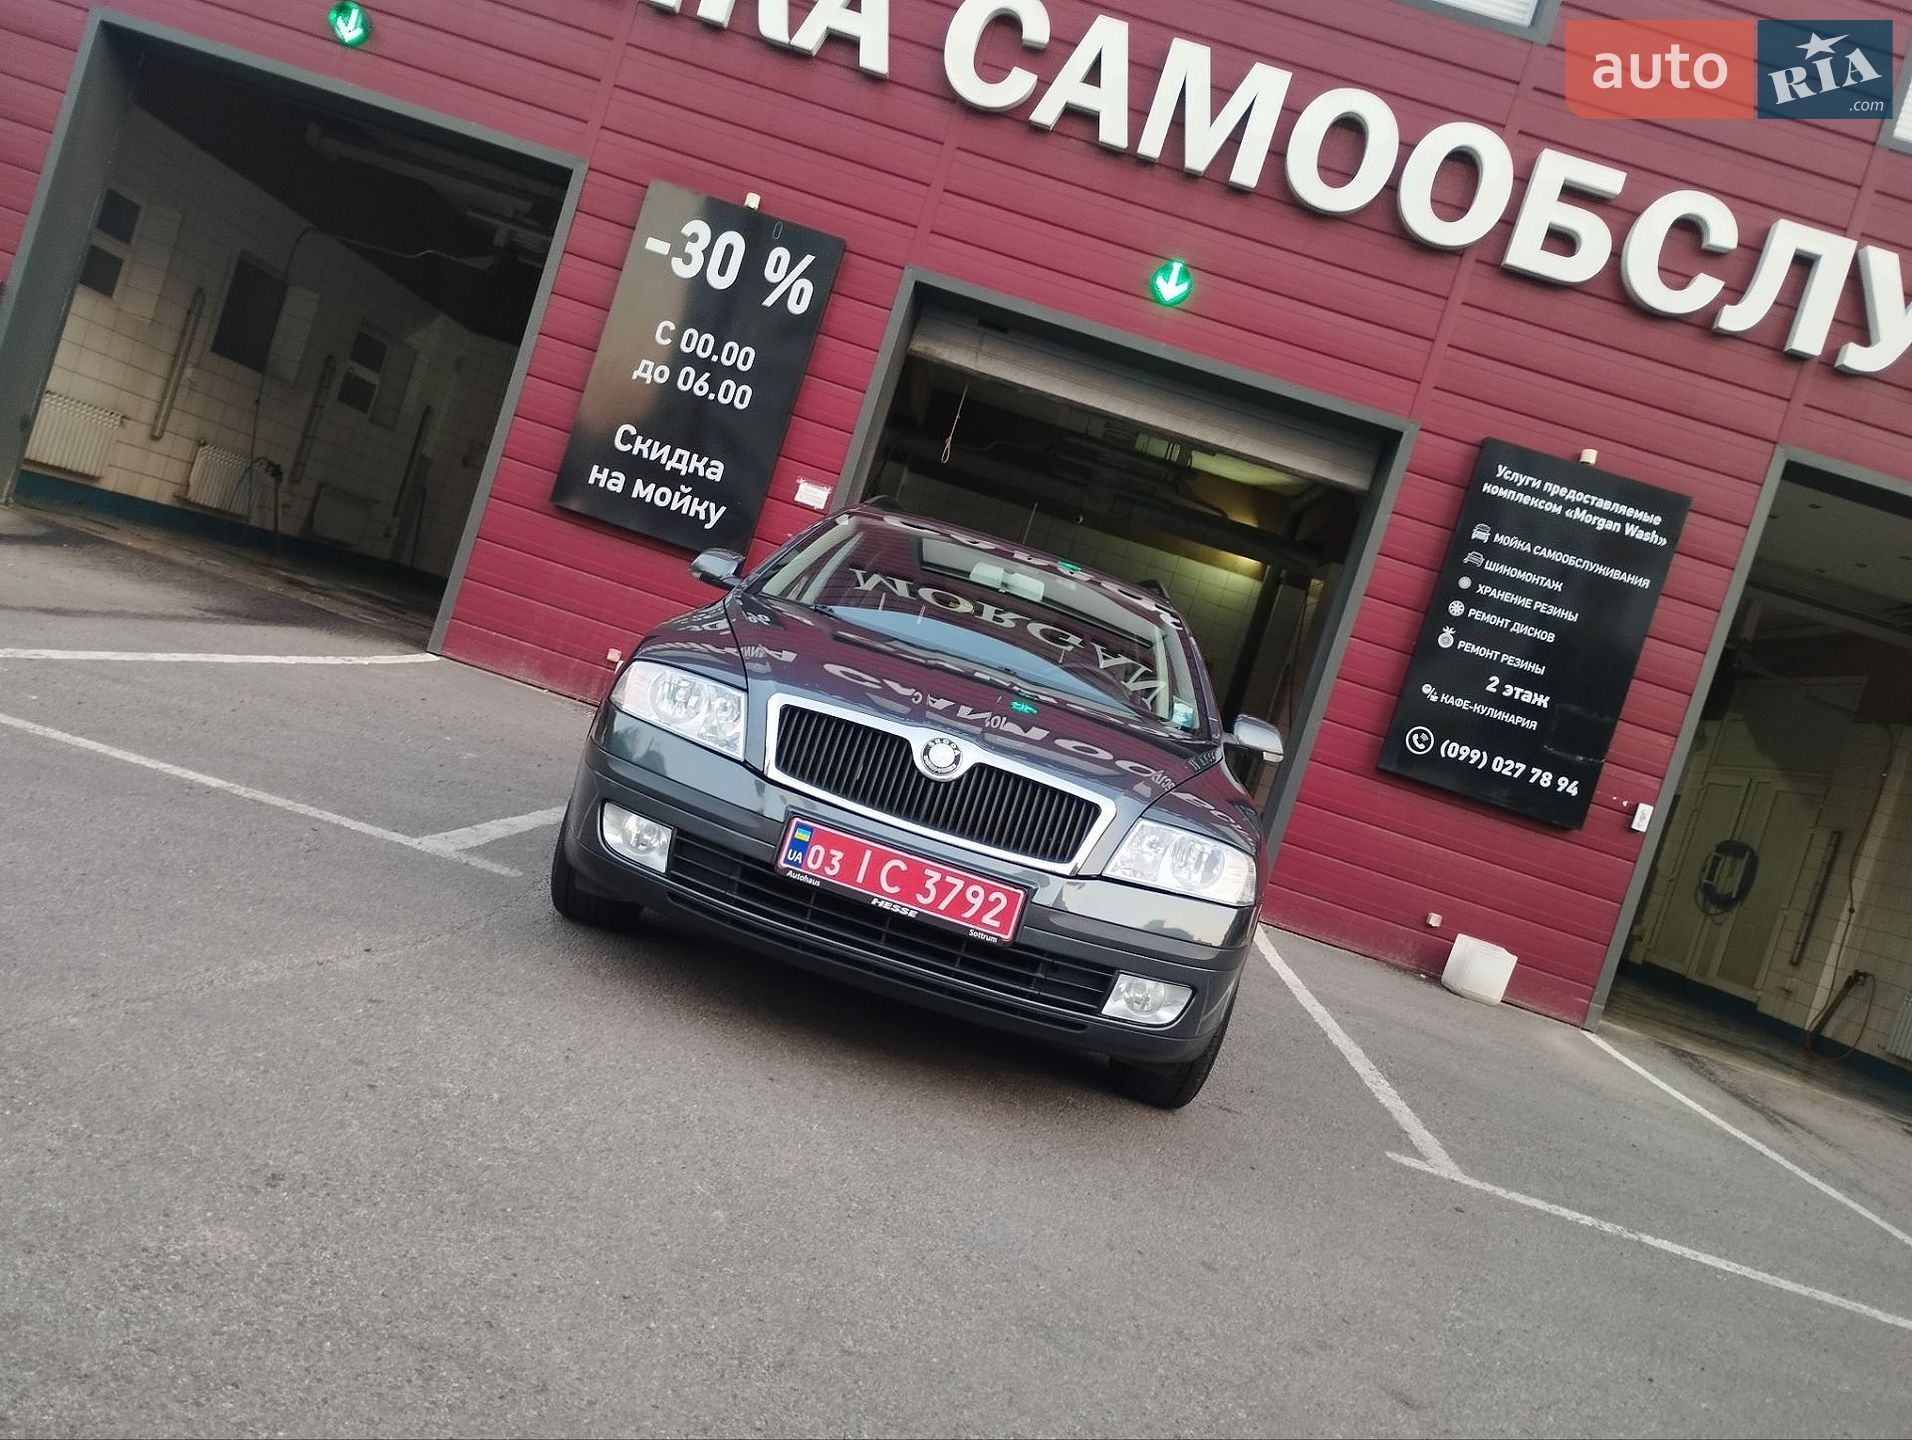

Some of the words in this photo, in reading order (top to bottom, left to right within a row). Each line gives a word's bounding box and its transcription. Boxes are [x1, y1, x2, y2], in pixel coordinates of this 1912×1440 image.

[645, 219, 746, 290] -30
[762, 246, 816, 315] %
[680, 327, 756, 371] 00.00
[632, 359, 671, 384] до
[676, 366, 753, 410] 06.00
[614, 423, 725, 482] Скидка
[588, 464, 625, 494] на
[632, 483, 727, 529] мойку
[1482, 482, 1563, 515] комплексом
[1495, 464, 1542, 489] Услуги
[1543, 481, 1663, 526] предоставляемые
[1484, 559, 1564, 593] ШИНОМОНТАЖ
[1493, 532, 1531, 553] МОЙКА
[1533, 545, 1651, 589] САМООБСЛУЖИВАНИЯ
[1476, 583, 1533, 609] ХРАНЕНИЕ
[1533, 600, 1579, 622] РЕЗИНЫ
[1467, 608, 1511, 630] РЕМОНТ
[1510, 621, 1556, 643] ДИСКОВ
[1457, 640, 1501, 661] РЕМОНТ
[1500, 653, 1546, 676] РЕЗИНЫ
[1485, 675, 1500, 693] 2
[1502, 683, 1551, 709] этаж
[1440, 693, 1538, 731] КАФЕ-КУЛИНАРИЯ
[1440, 739, 1488, 769] (099)
[1491, 756, 1526, 779] 027
[1530, 767, 1553, 788] 78
[1556, 776, 1581, 797] 94
[787, 848, 803, 865] UA
[786, 869, 821, 887] Autohaus
[806, 844, 845, 876] 03
[915, 868, 1008, 928] 3792
[871, 898, 919, 919] HESSE
[969, 928, 998, 943] Sottrum
